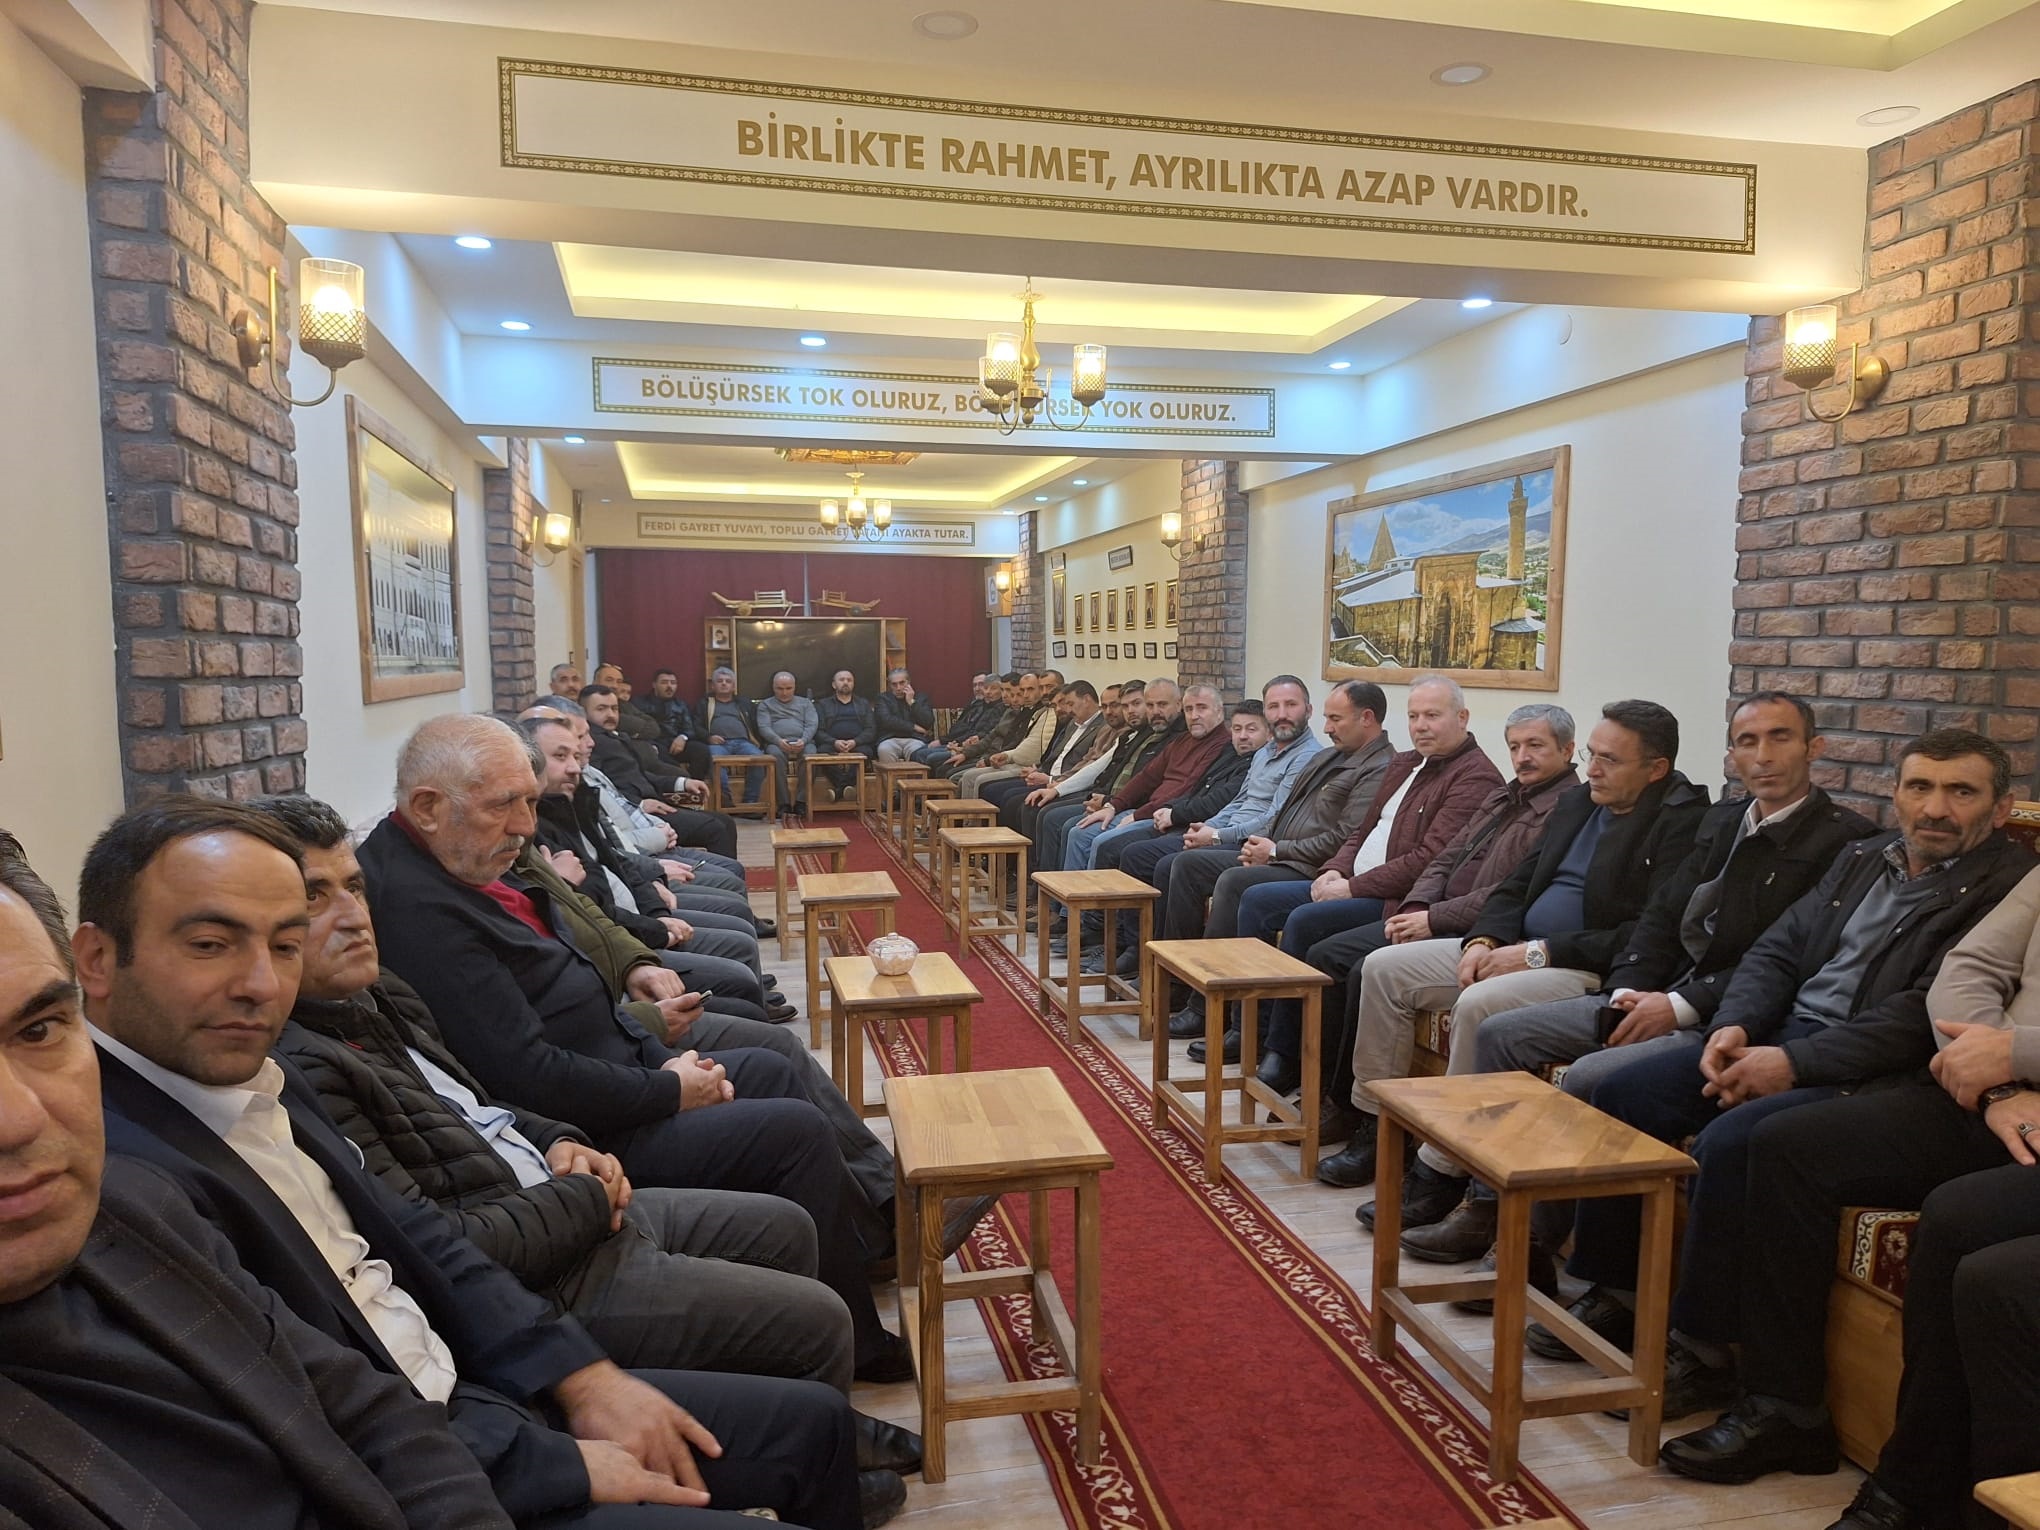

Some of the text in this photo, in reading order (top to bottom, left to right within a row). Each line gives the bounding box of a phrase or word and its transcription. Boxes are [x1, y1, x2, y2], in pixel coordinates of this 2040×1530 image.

[737, 111, 1590, 217] BİRLİKTE RAHMET, AYRILIKTA AZAP VARDIR.
[641, 374, 791, 406] BÖLÜŞÜRSEK
[798, 386, 845, 407] TOK
[851, 389, 948, 414] OLURUZ,
[1101, 401, 1143, 419] YOK
[1150, 402, 1236, 422] OLURUZ.
[645, 519, 676, 531] FERDİ
[680, 522, 721, 533] GAYRET
[770, 526, 804, 536] TOPLU
[892, 529, 932, 539] AYAKTA
[935, 530, 969, 540] TUTAR.
